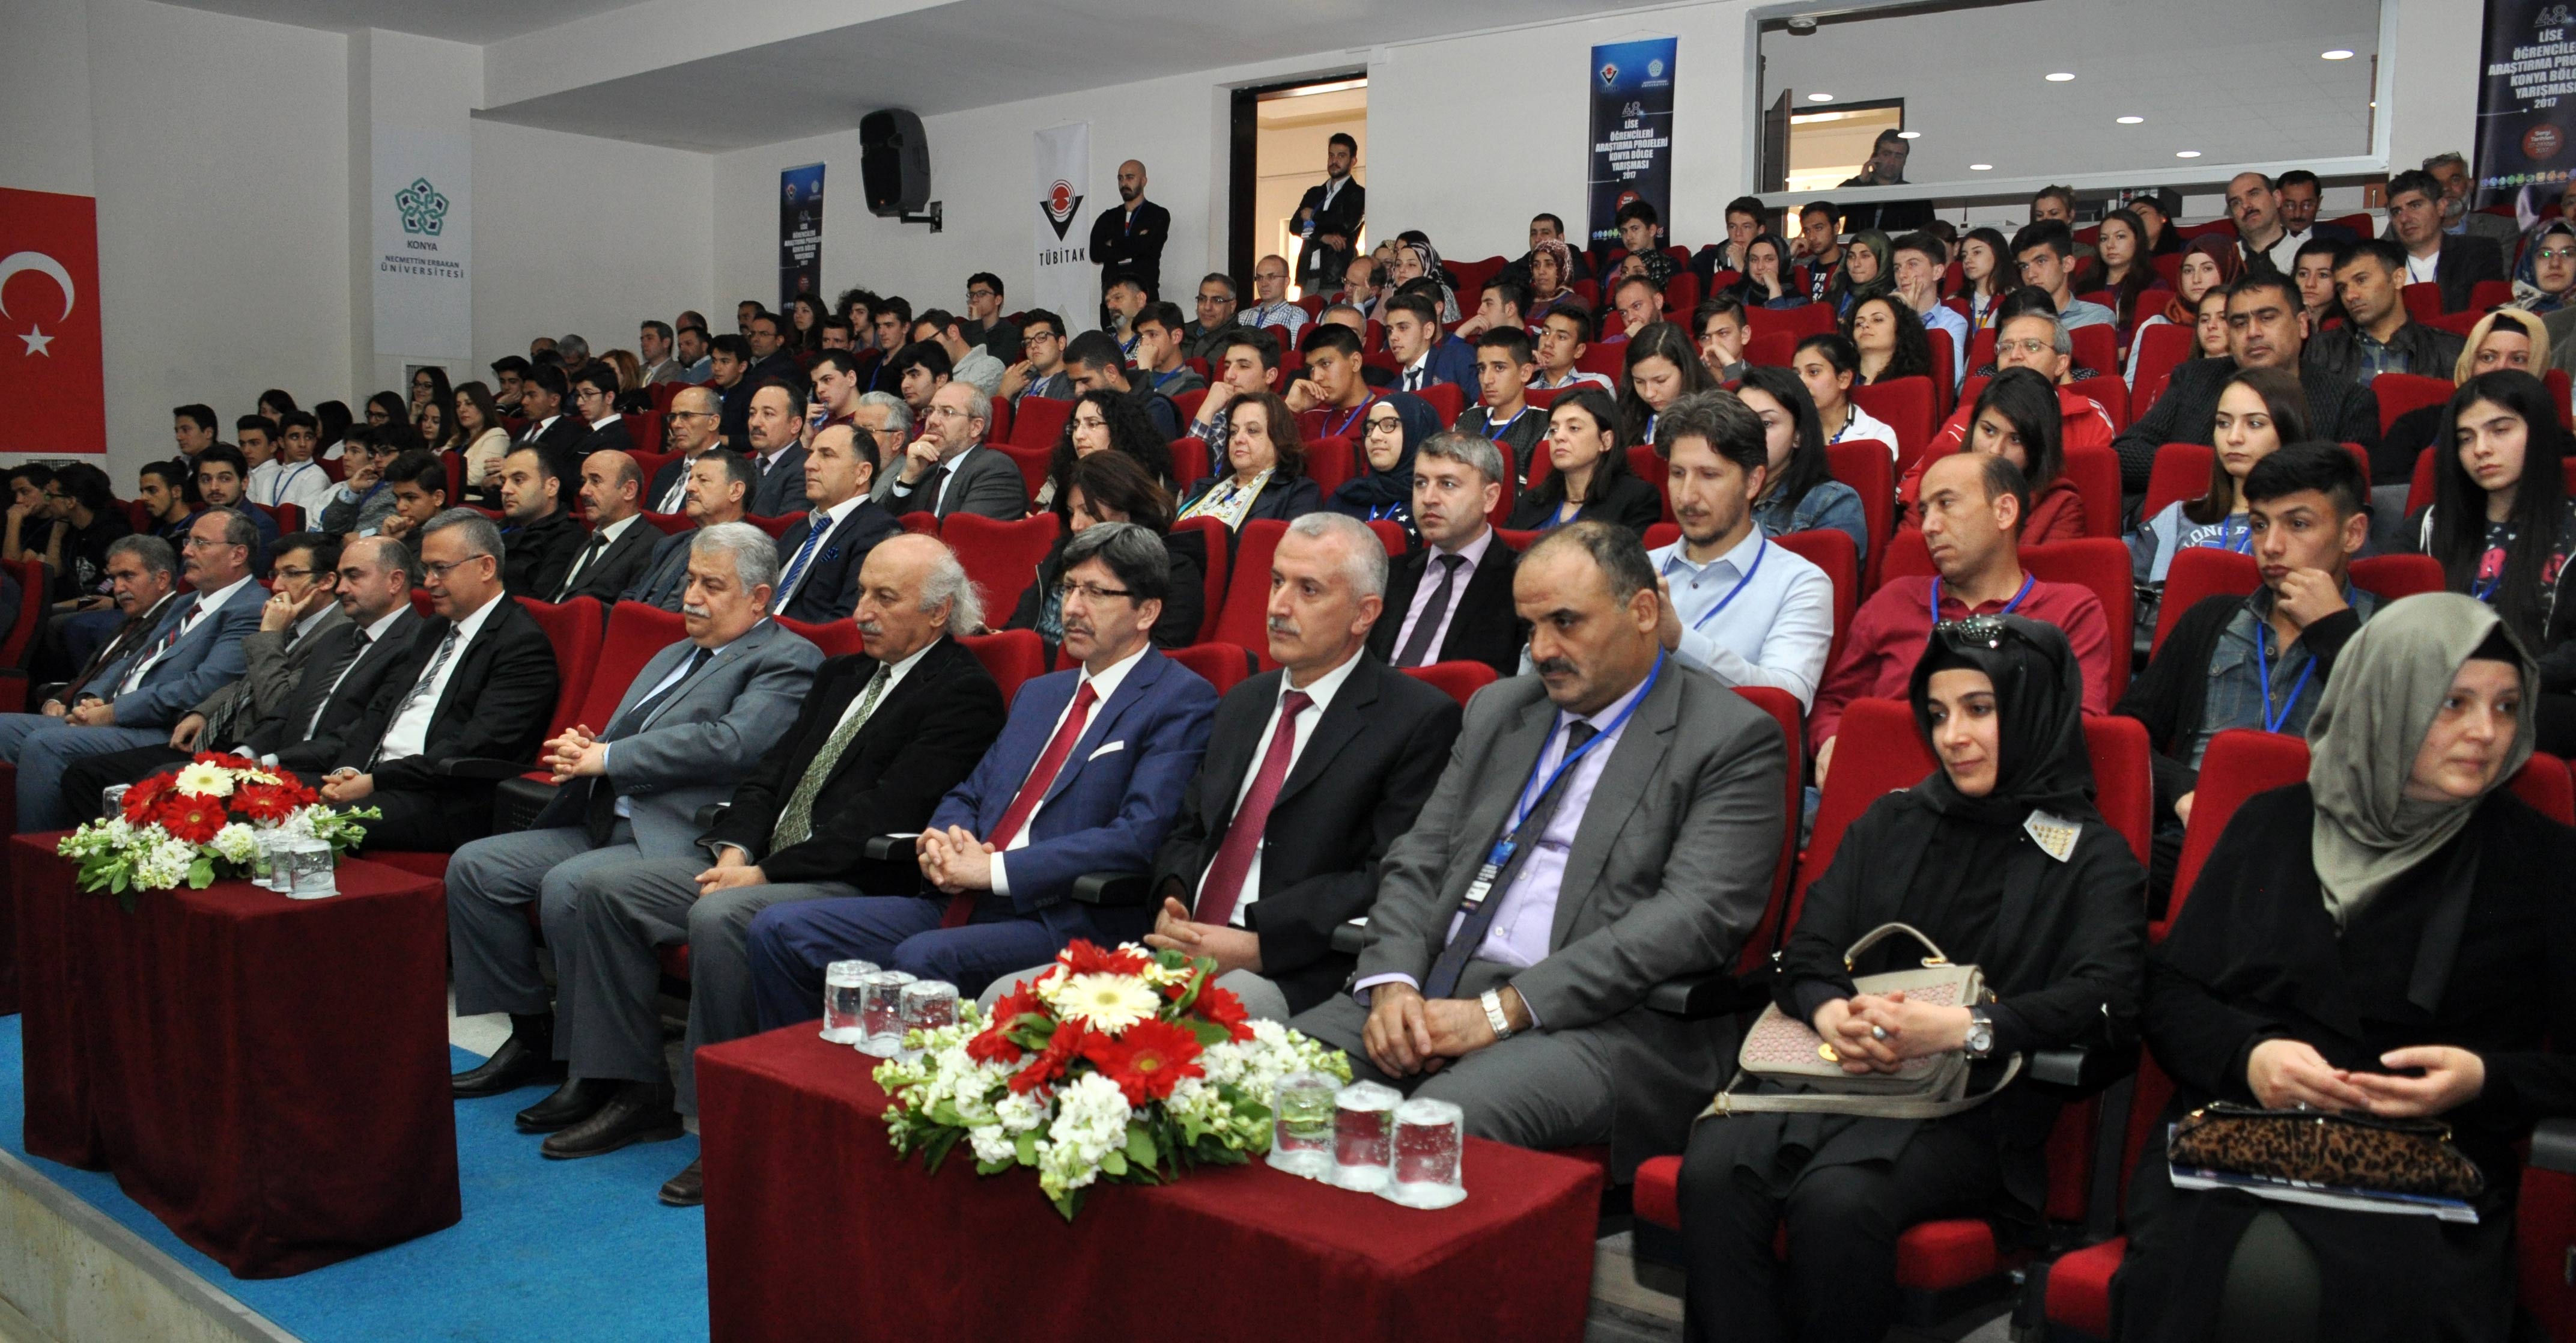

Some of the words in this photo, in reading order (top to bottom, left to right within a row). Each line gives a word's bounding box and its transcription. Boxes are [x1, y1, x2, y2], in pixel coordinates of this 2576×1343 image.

[2539, 29, 2563, 43] LİSE
[2513, 41, 2576, 60] ÖĞRENCİLE
[2488, 58, 2553, 76] ARAŞTIRMA
[2511, 72, 2547, 87] KONYA
[2534, 97, 2557, 109] 2017
[1624, 118, 1639, 129] LİSE
[1610, 127, 1654, 141] ÖĞRENCİLERİ
[1596, 141, 1633, 153] ARAŞTIRMA
[1633, 136, 1668, 148] PROJELERİ
[1609, 151, 1630, 162] KONYA
[1631, 149, 1653, 159] BÖLGE
[1612, 160, 1649, 171] YARIŞMASI
[1623, 171, 1636, 180] 2017
[407, 240, 438, 251] KONYA
[385, 255, 425, 265] NECMETTİN
[427, 260, 460, 268] ERBAKAN
[1039, 248, 1085, 266] TÜBİTAK
[381, 262, 464, 278] ÜNİVERSİTESİ
